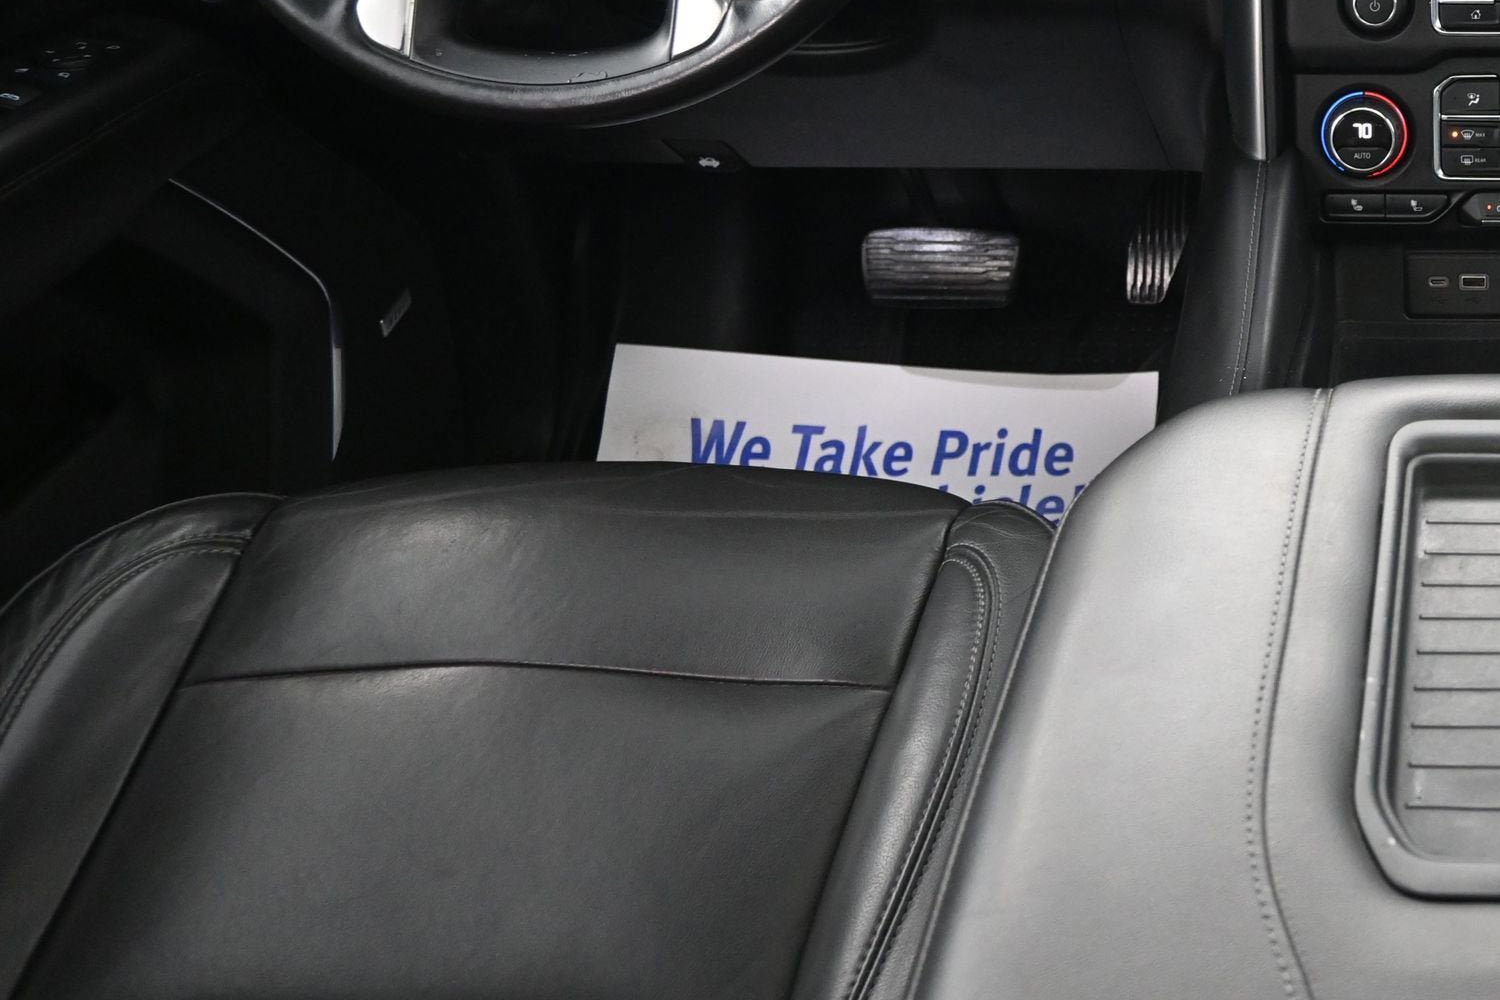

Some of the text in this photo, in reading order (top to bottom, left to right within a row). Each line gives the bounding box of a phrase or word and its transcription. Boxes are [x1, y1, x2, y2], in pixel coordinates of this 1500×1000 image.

[1352, 122, 1372, 139] 70
[1353, 152, 1371, 160] AUTO
[690, 417, 1074, 478] We Take Pride
